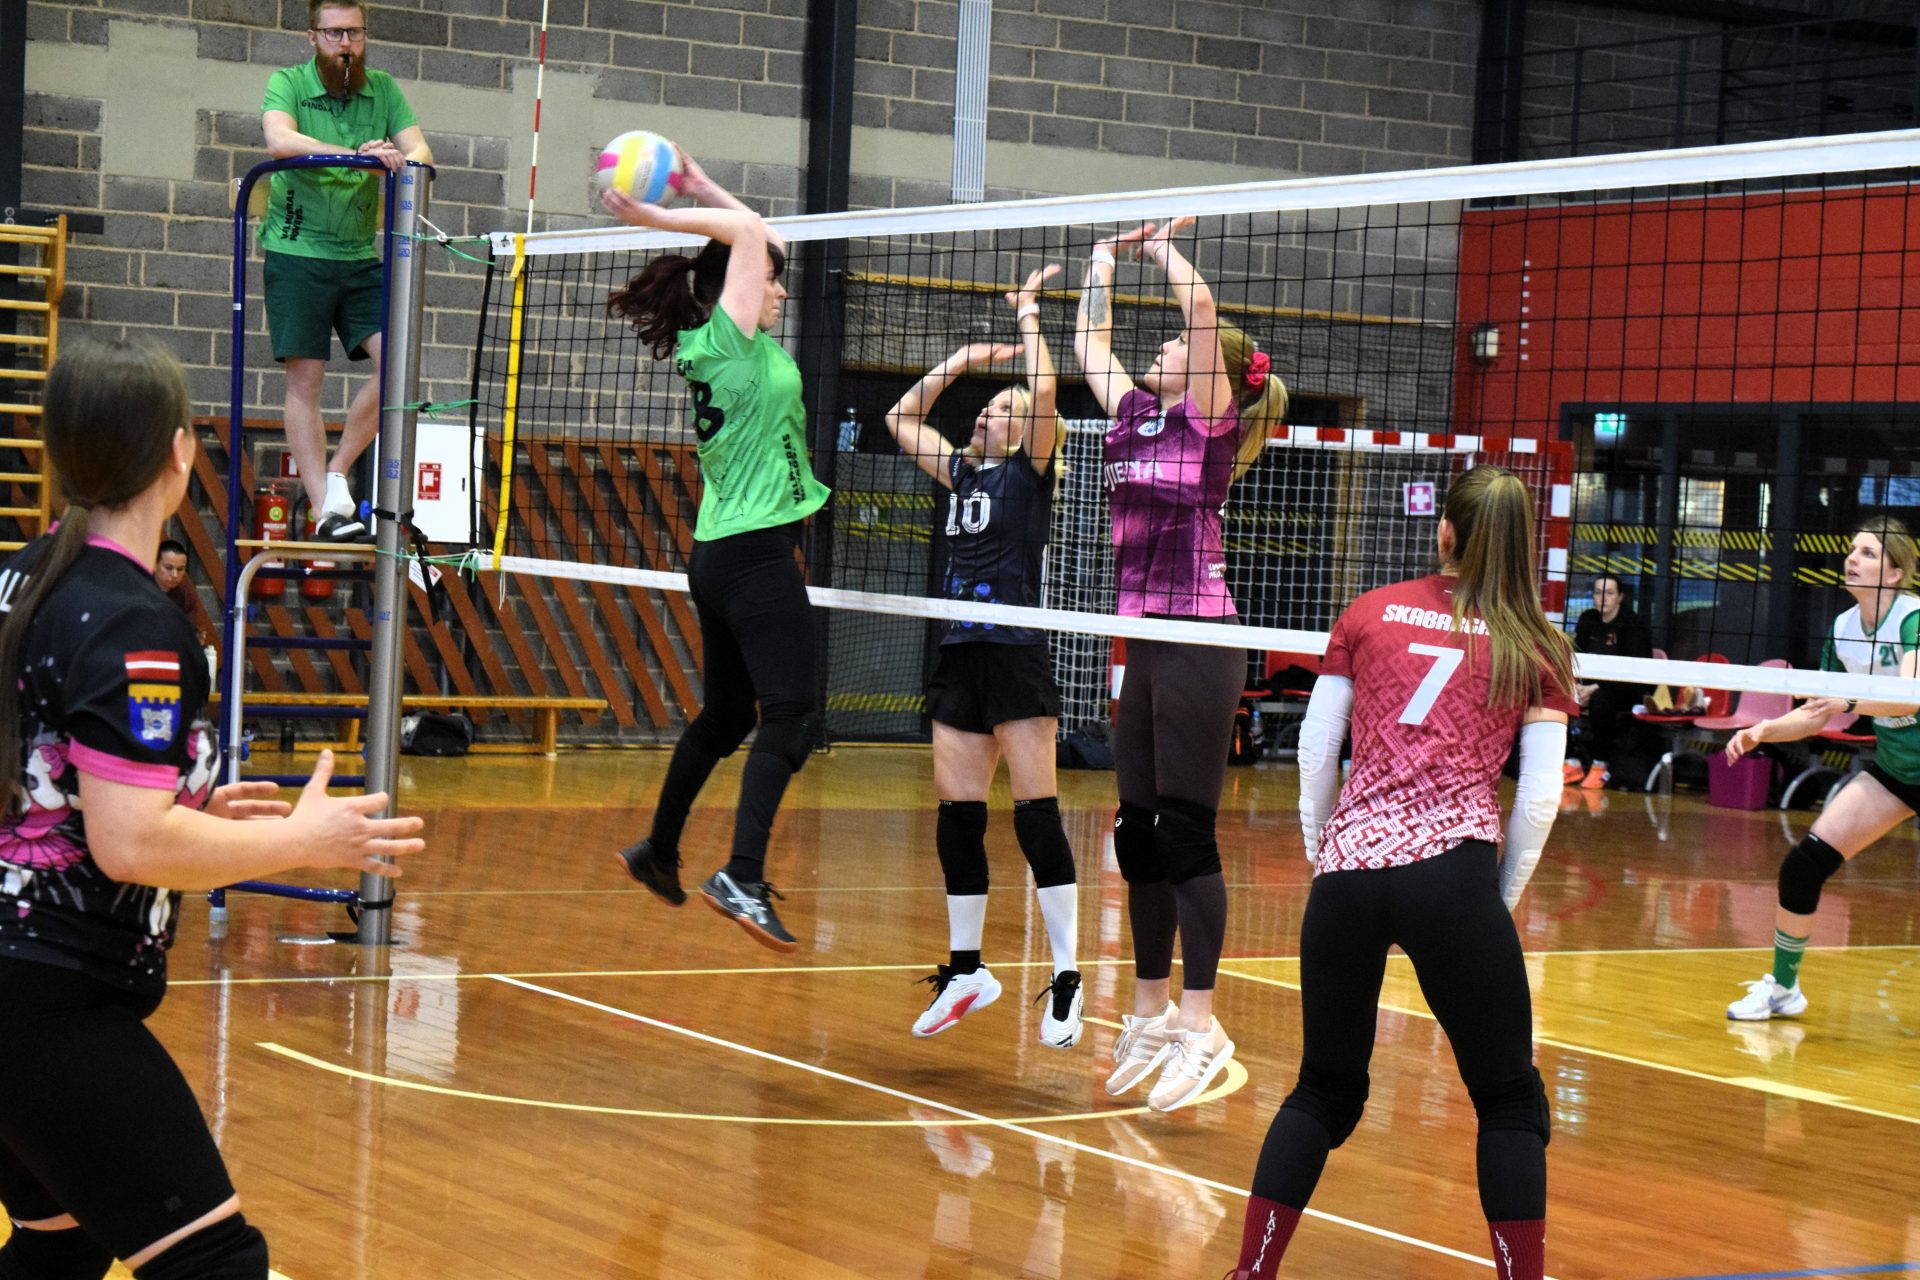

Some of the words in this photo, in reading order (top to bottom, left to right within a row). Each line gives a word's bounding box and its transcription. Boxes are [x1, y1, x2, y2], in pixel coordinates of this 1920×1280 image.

[689, 380, 725, 442] 8
[946, 492, 991, 535] 10
[1398, 642, 1465, 726] 7
